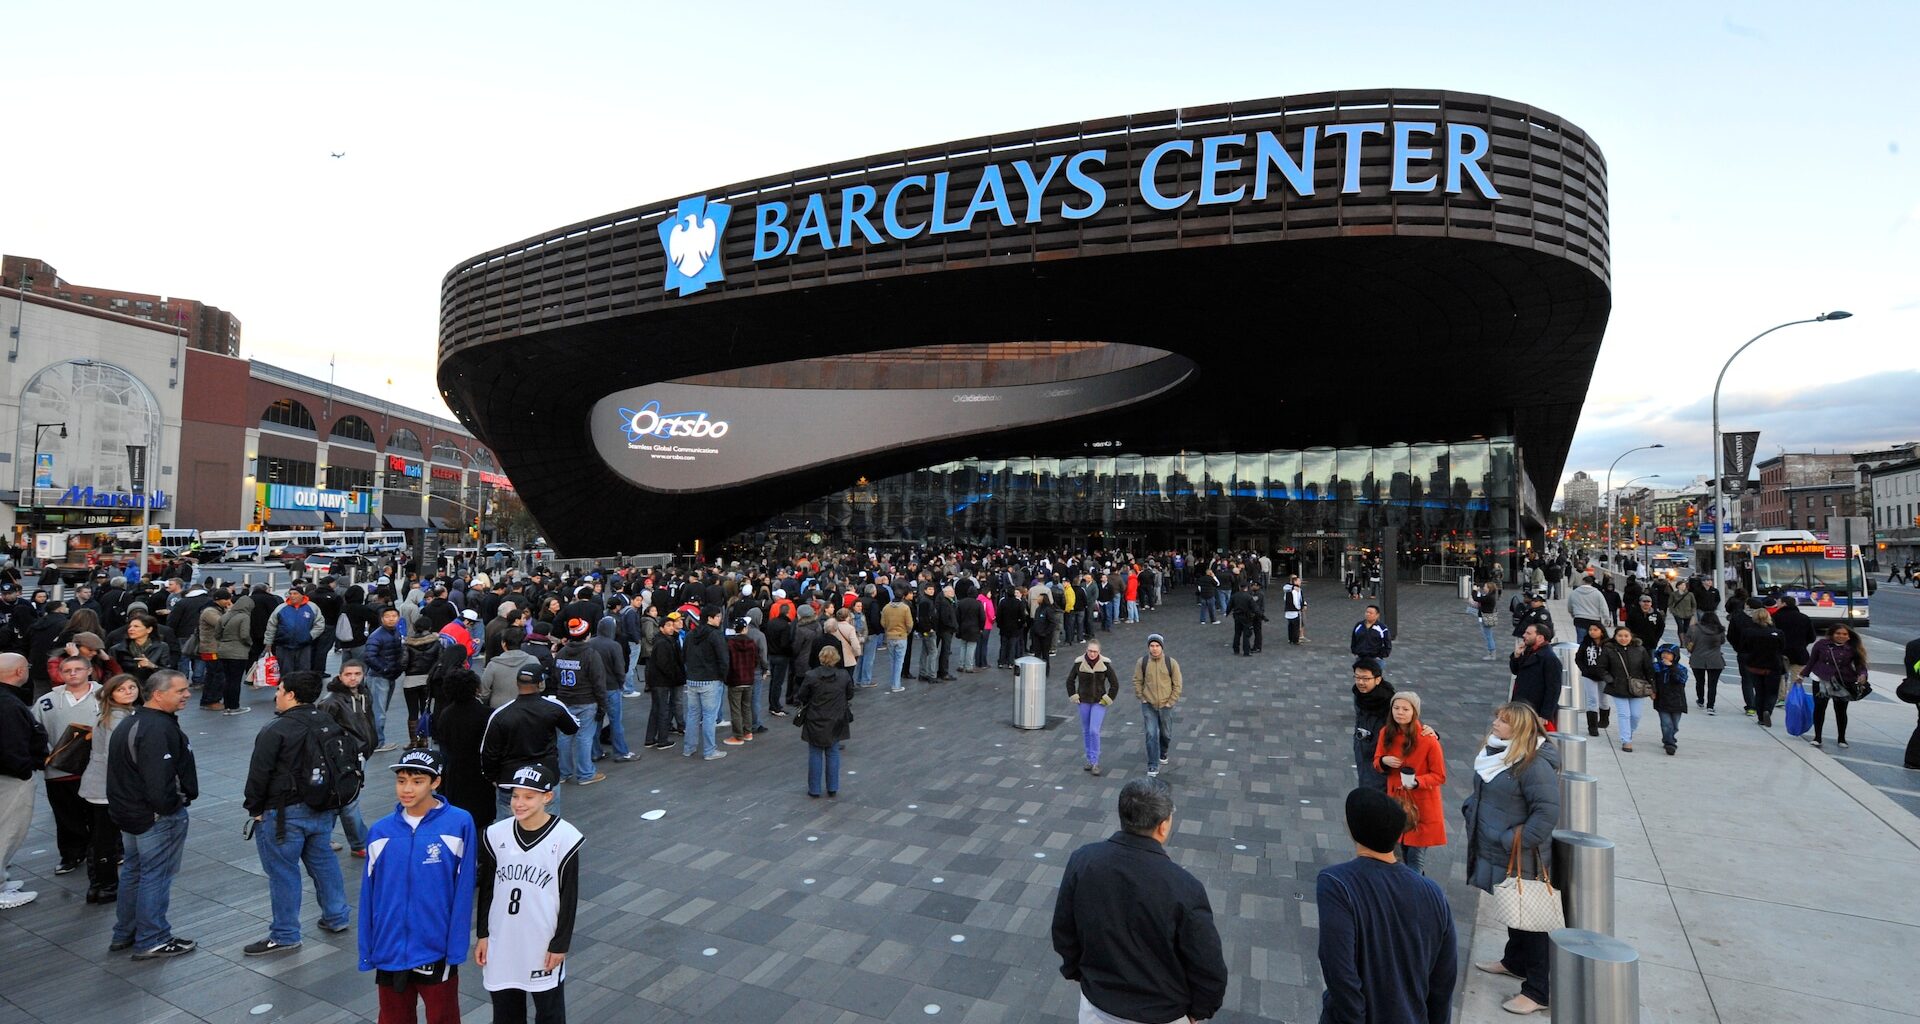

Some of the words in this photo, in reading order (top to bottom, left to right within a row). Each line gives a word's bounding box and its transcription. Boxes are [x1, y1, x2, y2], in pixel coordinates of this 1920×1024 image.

[752, 149, 1107, 262] BARCLAYS
[1138, 121, 1503, 211] CENTER
[631, 410, 729, 438] Ortsbo
[653, 444, 672, 452] Global
[672, 446, 719, 454] Communications
[294, 491, 318, 507] OLD
[319, 493, 347, 509] NAVY
[1796, 545, 1825, 553] FLATBUS
[560, 669, 576, 687] 13
[40, 698, 53, 711] 3
[402, 751, 434, 765] BROOKLYN
[513, 767, 542, 782] BROOKLYN
[496, 864, 553, 889] BROOKLYN
[508, 887, 522, 915] 8
